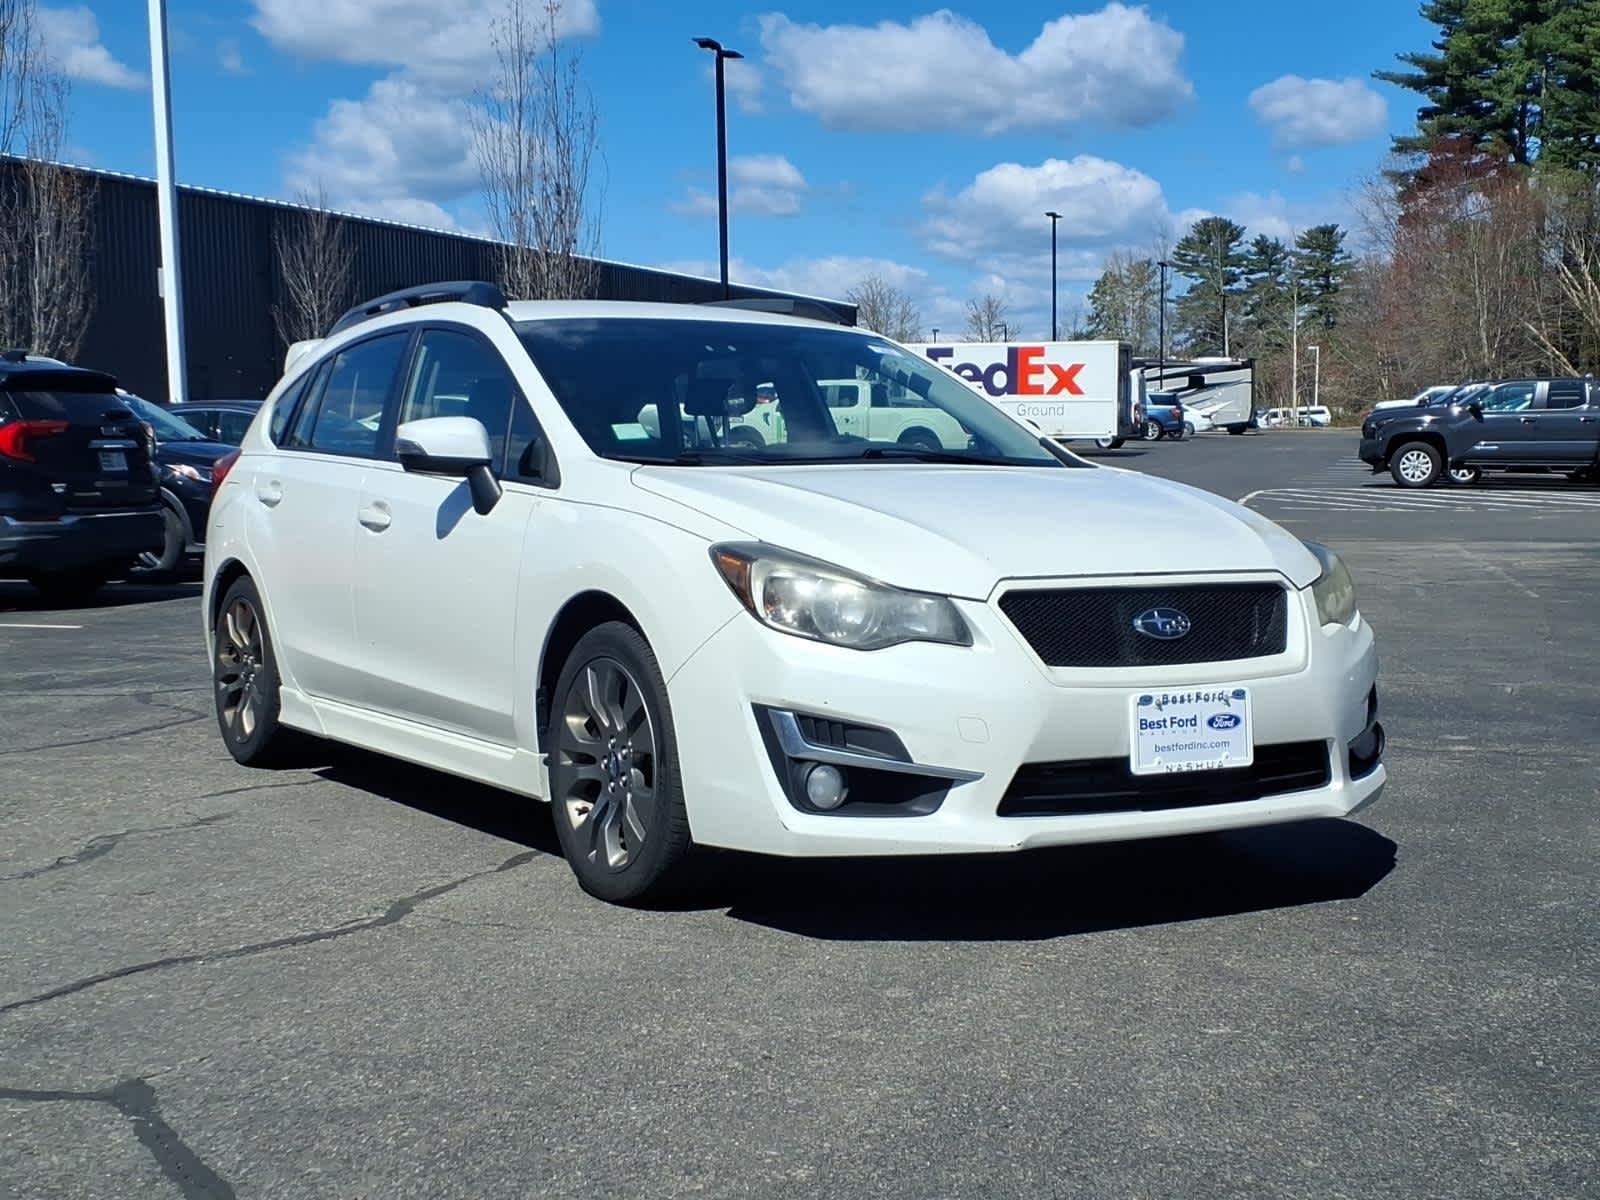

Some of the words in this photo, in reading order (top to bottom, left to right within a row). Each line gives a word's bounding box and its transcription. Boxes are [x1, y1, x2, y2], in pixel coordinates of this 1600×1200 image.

[1016, 403, 1064, 417] Ground
[1161, 693, 1191, 705] Best
[1195, 690, 1224, 702] Ford
[1140, 717, 1168, 730] Best
[1170, 714, 1197, 728] Ford
[1154, 740, 1230, 752] bestfordinc.com
[1166, 760, 1224, 772] NASHUA
